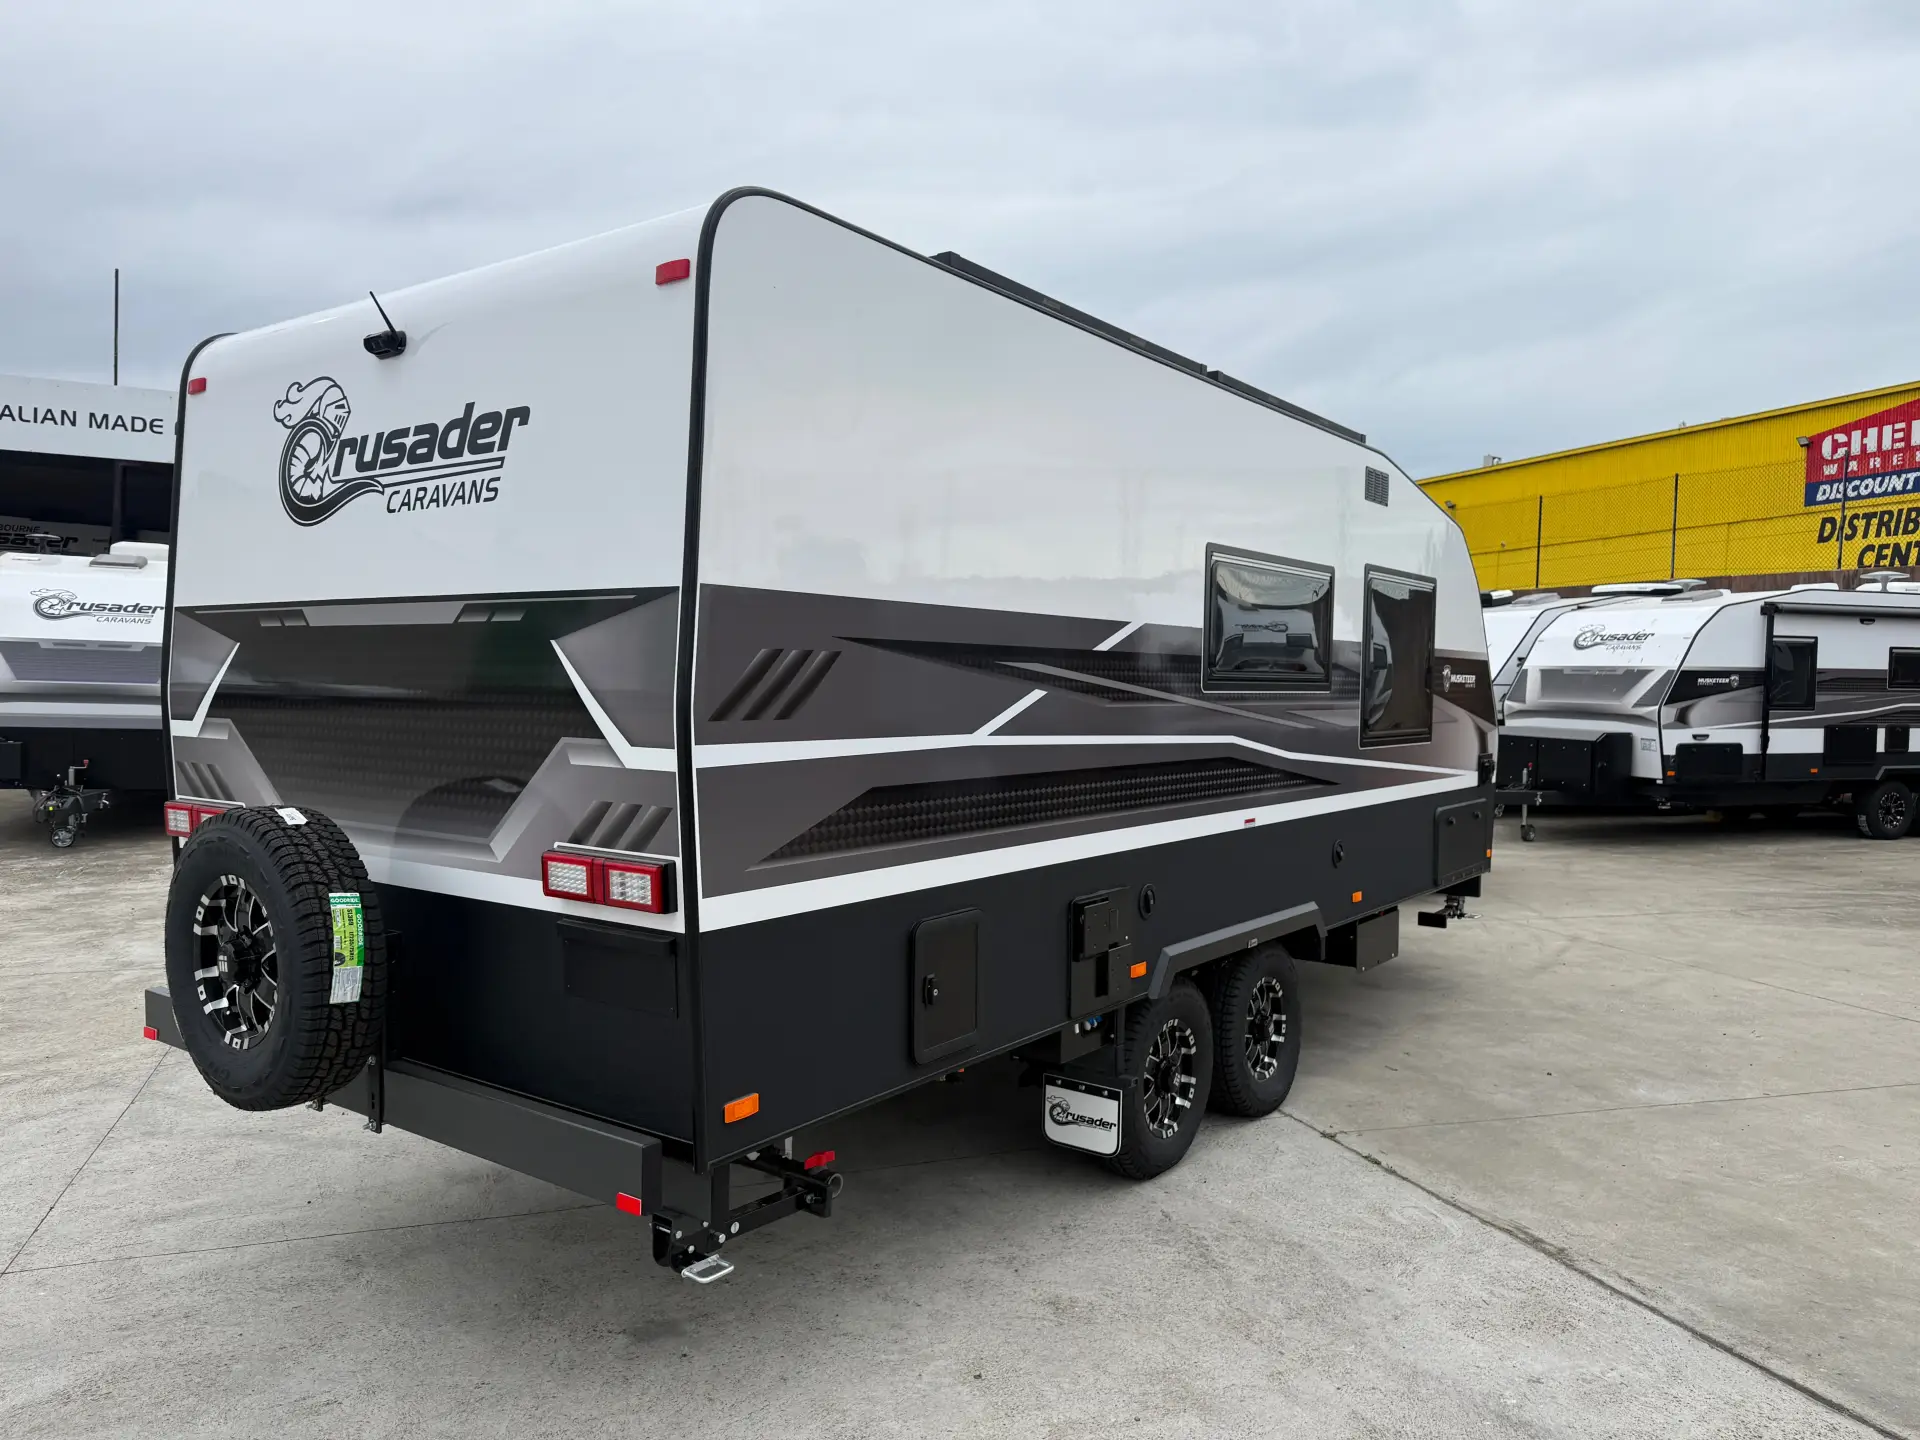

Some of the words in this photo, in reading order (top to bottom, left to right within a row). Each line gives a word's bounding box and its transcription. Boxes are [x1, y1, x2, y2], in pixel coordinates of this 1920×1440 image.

[89, 412, 164, 435] MADE
[279, 401, 531, 527] Crusader
[386, 477, 501, 514] CARAVANS
[1816, 471, 1920, 501] DISCOUNT
[33, 596, 164, 620] Crusader
[96, 616, 152, 624] CARAVANS
[1049, 1104, 1117, 1130] Crusader
